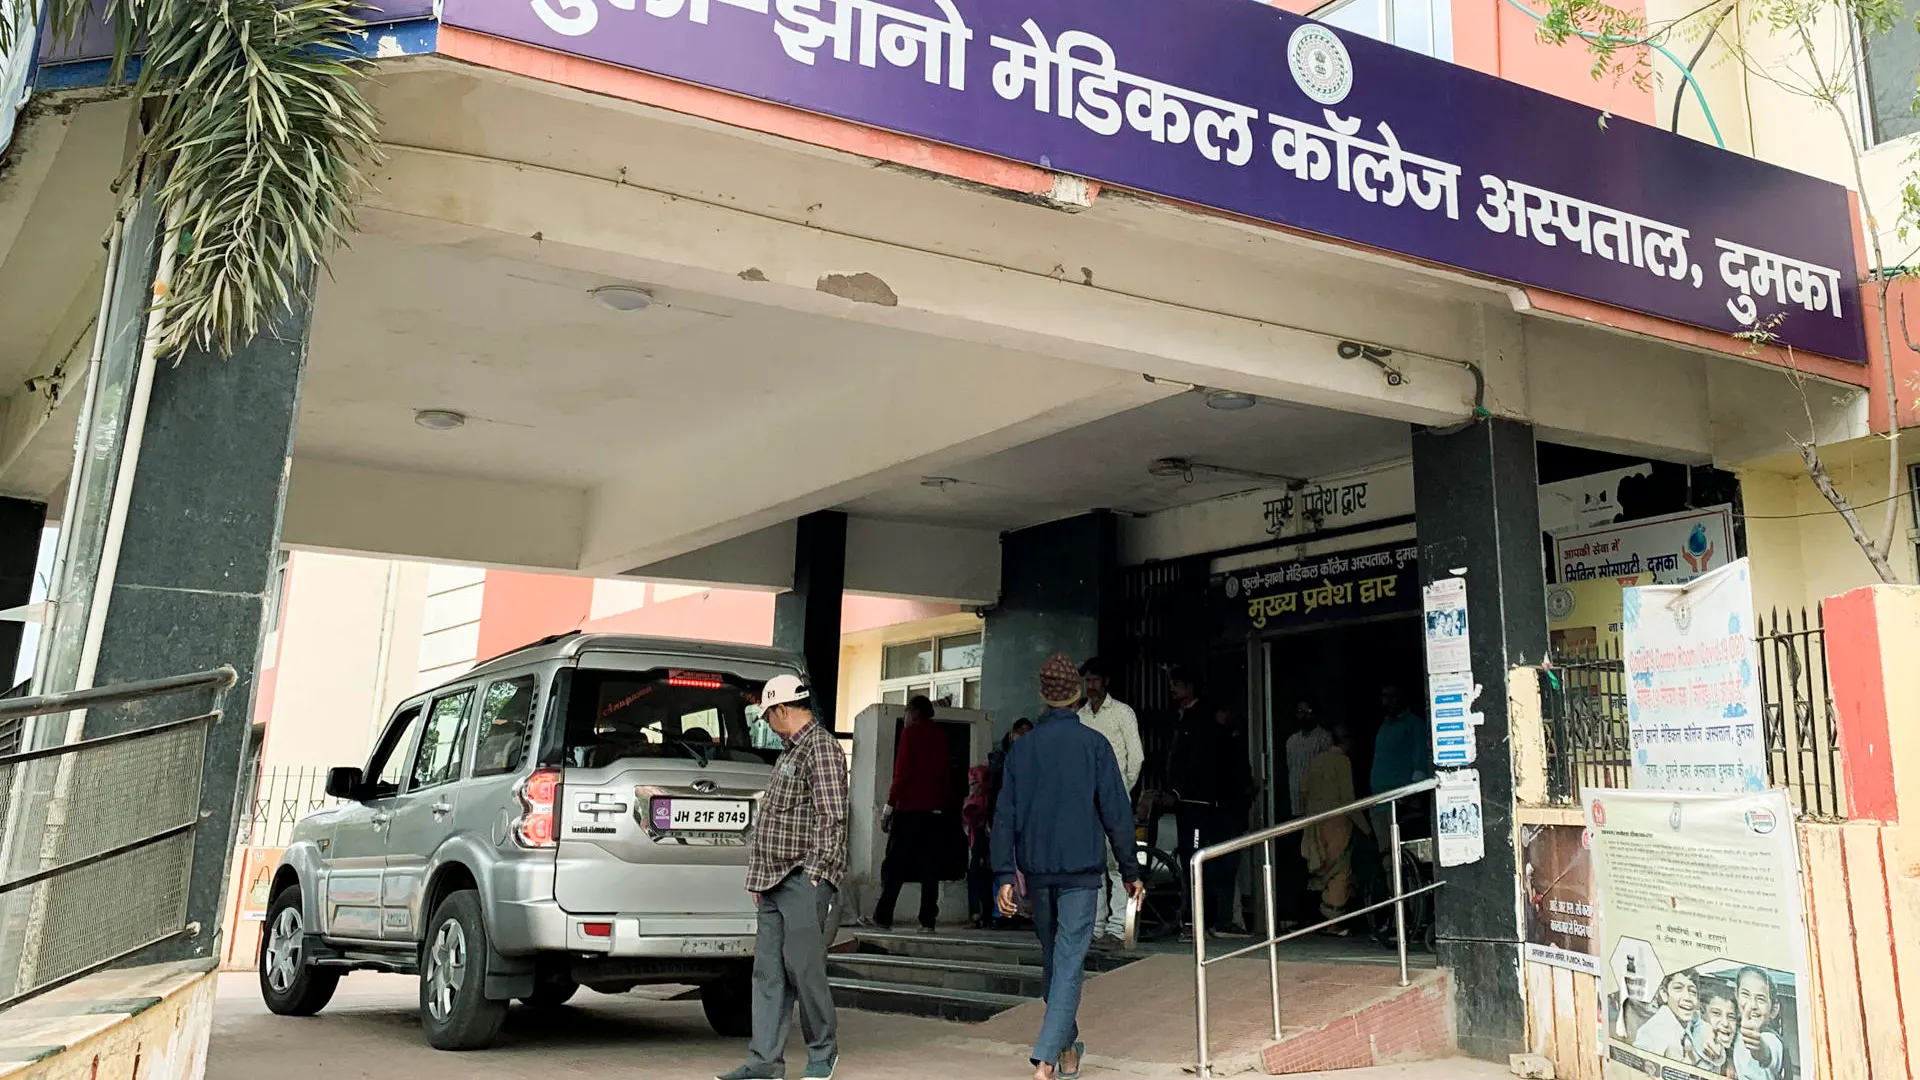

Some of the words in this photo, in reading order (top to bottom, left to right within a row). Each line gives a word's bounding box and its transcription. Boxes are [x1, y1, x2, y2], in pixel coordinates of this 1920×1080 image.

[989, 17, 1258, 166] मेडिकल
[1269, 108, 1462, 219] कॉलेज
[1477, 174, 1702, 289] अस्पताल,
[1715, 238, 1842, 325] दुमका
[1342, 482, 1368, 515] द्वार
[1564, 544, 1590, 560] आपकी
[1593, 542, 1609, 555] सेवा
[1611, 538, 1621, 552] में
[1286, 563, 1318, 582] मेडिकल
[1320, 556, 1349, 576] कॉलेज
[1565, 562, 1596, 583] सिविल
[1647, 553, 1678, 582] दुमका
[1248, 591, 1298, 629] मुख्य
[1302, 578, 1353, 615] प्रवेश
[1358, 574, 1398, 604] द्वार
[1735, 723, 1755, 747] दुमका
[674, 811, 690, 822] JH
[694, 811, 715, 823] 21F
[718, 811, 746, 823] 8749
